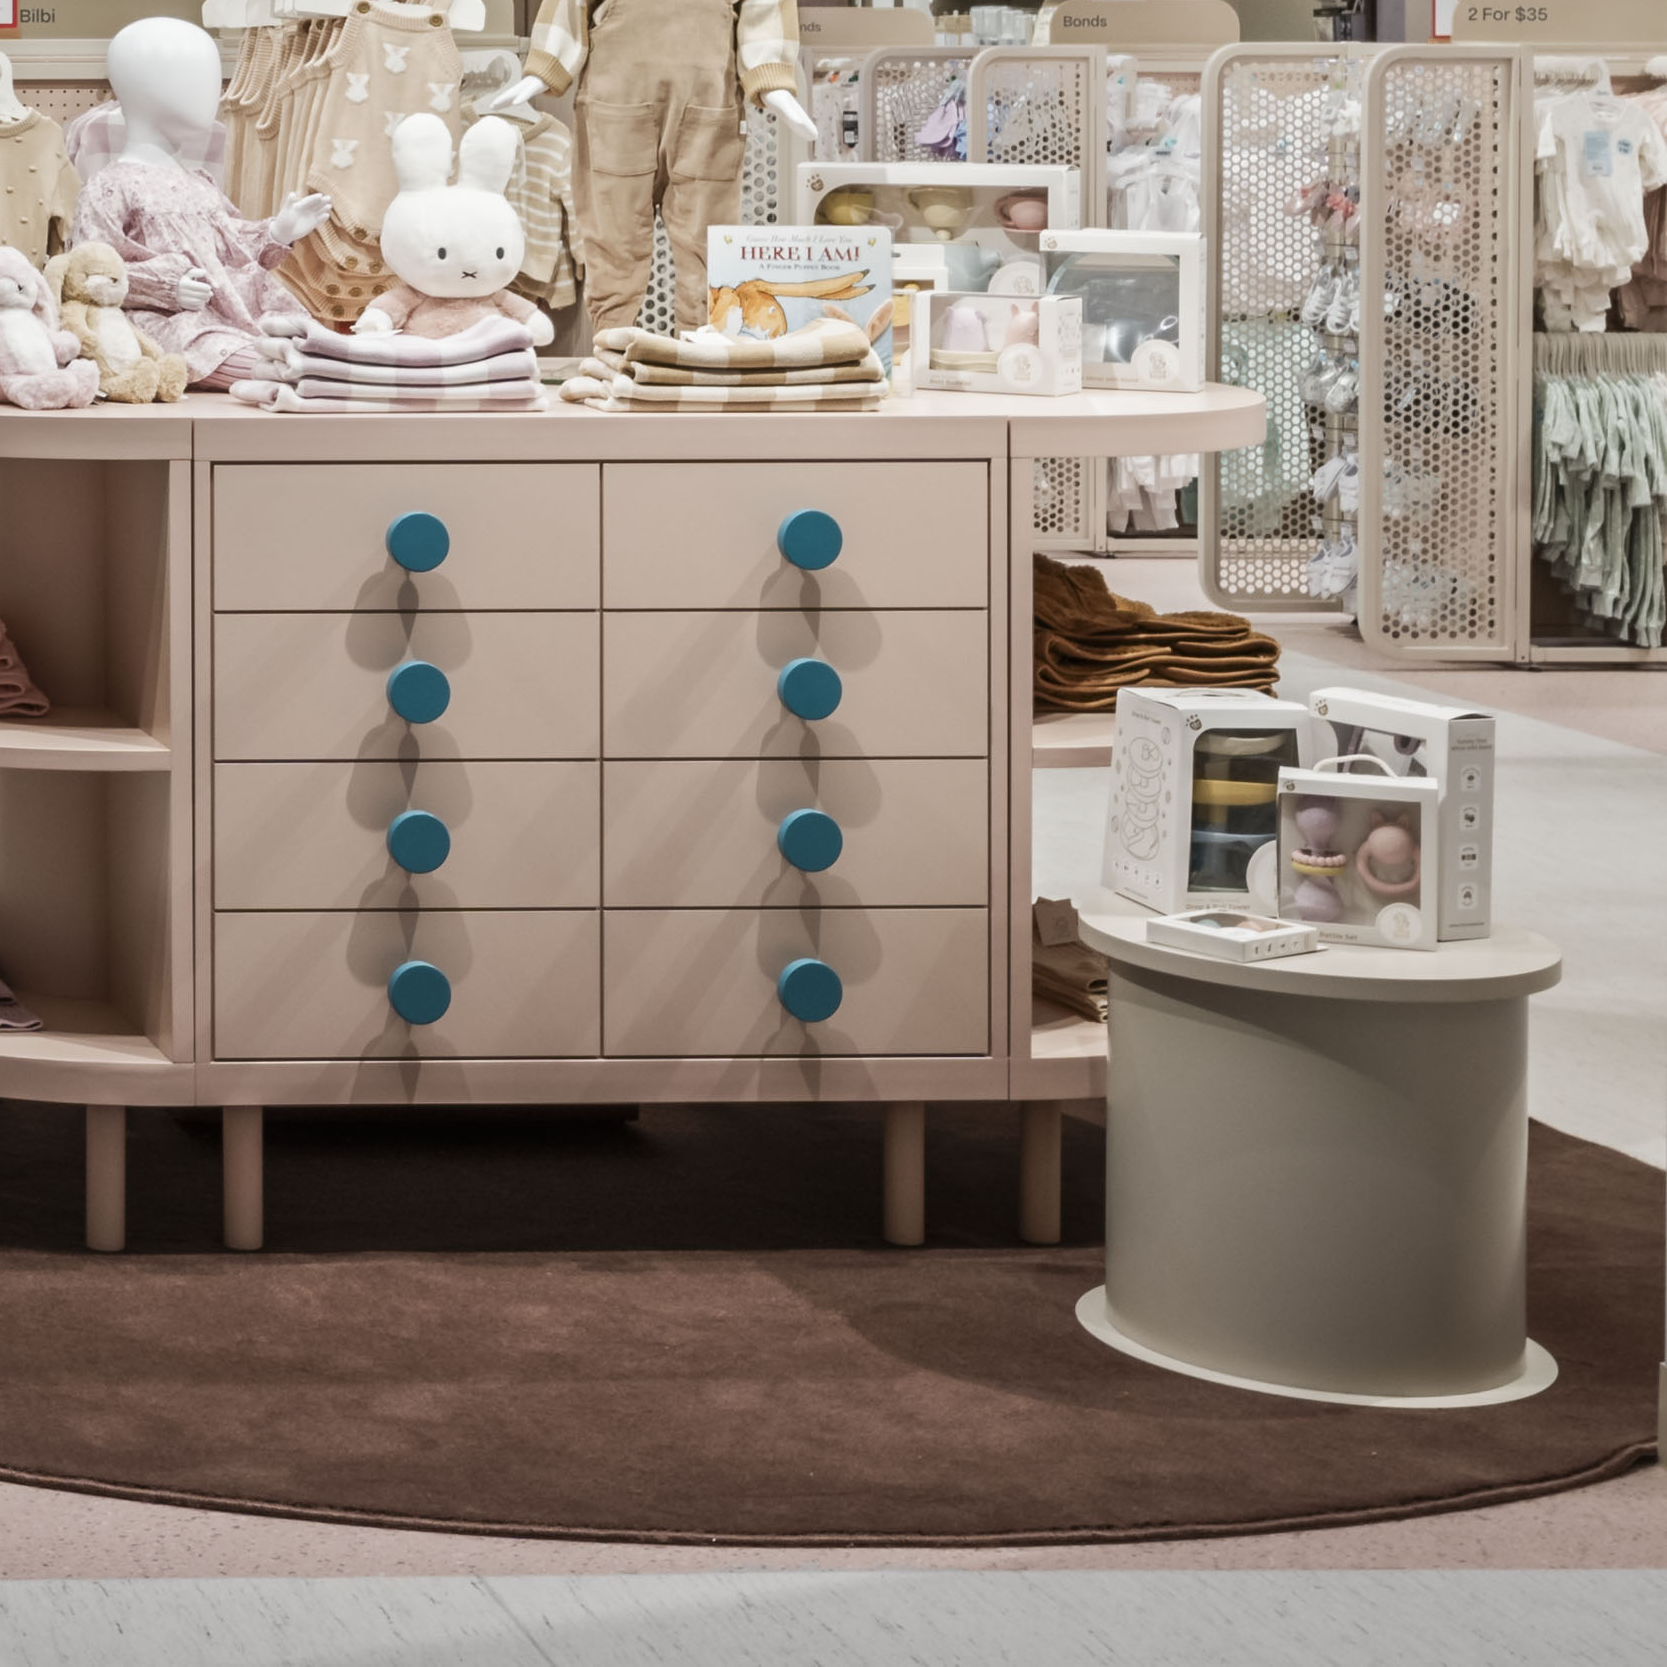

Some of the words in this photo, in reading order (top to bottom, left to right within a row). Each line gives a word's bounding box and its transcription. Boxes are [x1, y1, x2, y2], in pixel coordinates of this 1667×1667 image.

[20, 8, 55, 23] Bilbi
[1063, 15, 1108, 28] Bonds
[1468, 7, 1478, 21] 2
[1482, 7, 1511, 21] For
[1515, 6, 1548, 22] $35
[740, 246, 800, 261] HERE
[807, 246, 812, 261] I
[818, 246, 860, 262] AM!
